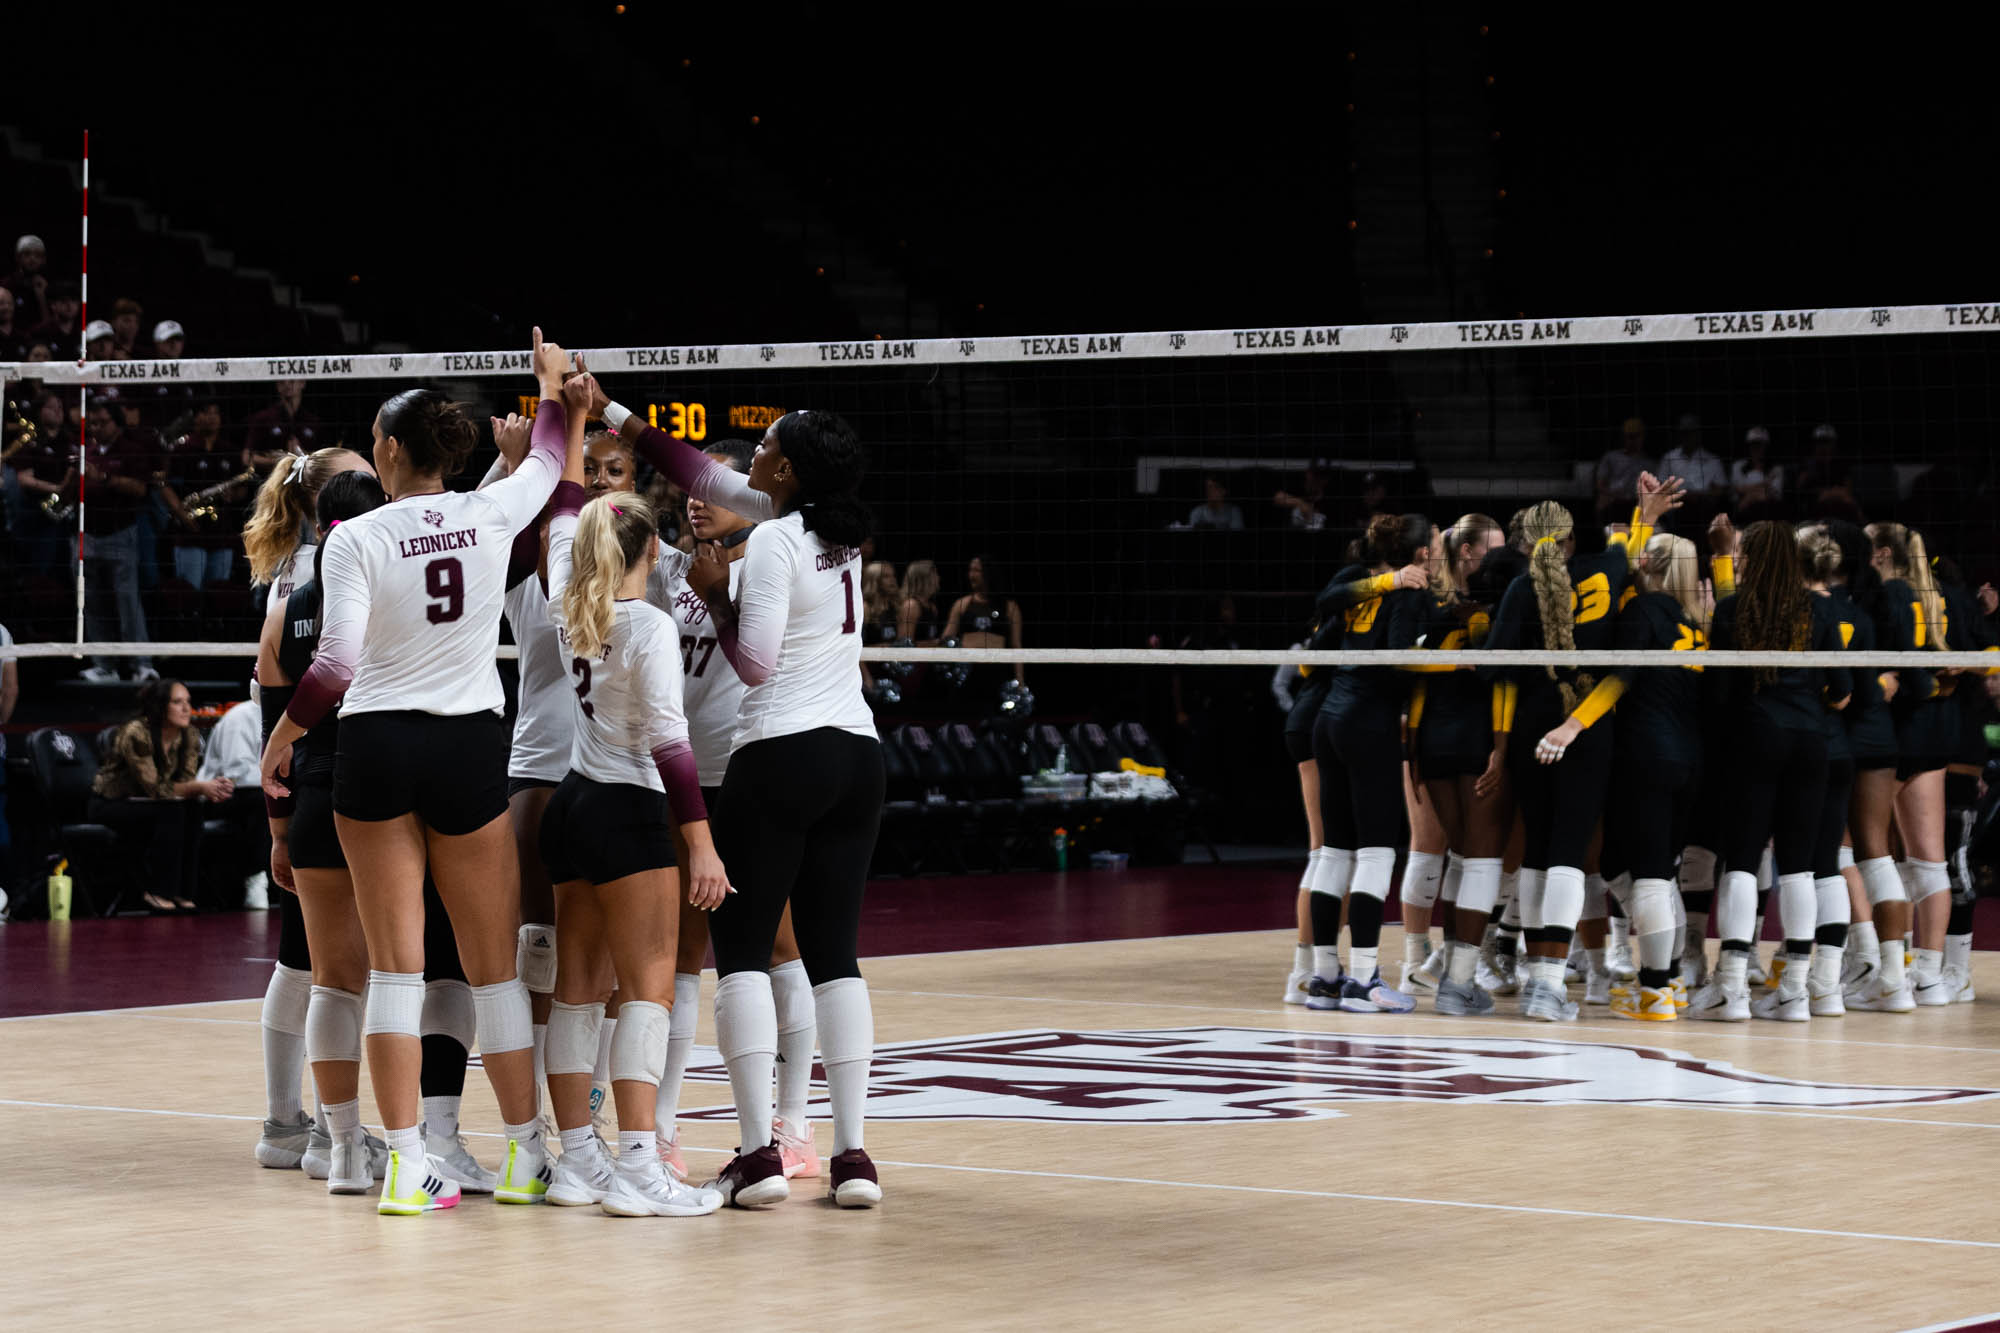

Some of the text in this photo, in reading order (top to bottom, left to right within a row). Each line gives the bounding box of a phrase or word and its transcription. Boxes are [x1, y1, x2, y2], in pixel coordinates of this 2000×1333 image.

[1457, 320, 1571, 342] TEXAS A&M
[1694, 311, 1815, 335] TEXAS A&M
[1020, 335, 1122, 356] TEXAS A&M
[1232, 328, 1341, 349] TEXAS A&M
[442, 353, 532, 371] TEXAS A&M
[626, 347, 719, 366] TEXAS A&M
[818, 342, 916, 361] TEXAS A&M
[100, 362, 181, 379] TEXAS A&M
[267, 358, 353, 376] TEXAS A&M
[648, 402, 707, 441] 1:30
[399, 528, 478, 558] LEDNICKY
[424, 556, 464, 626] 9
[840, 568, 856, 634] 1
[681, 634, 718, 678] 37
[572, 656, 597, 722] 2
